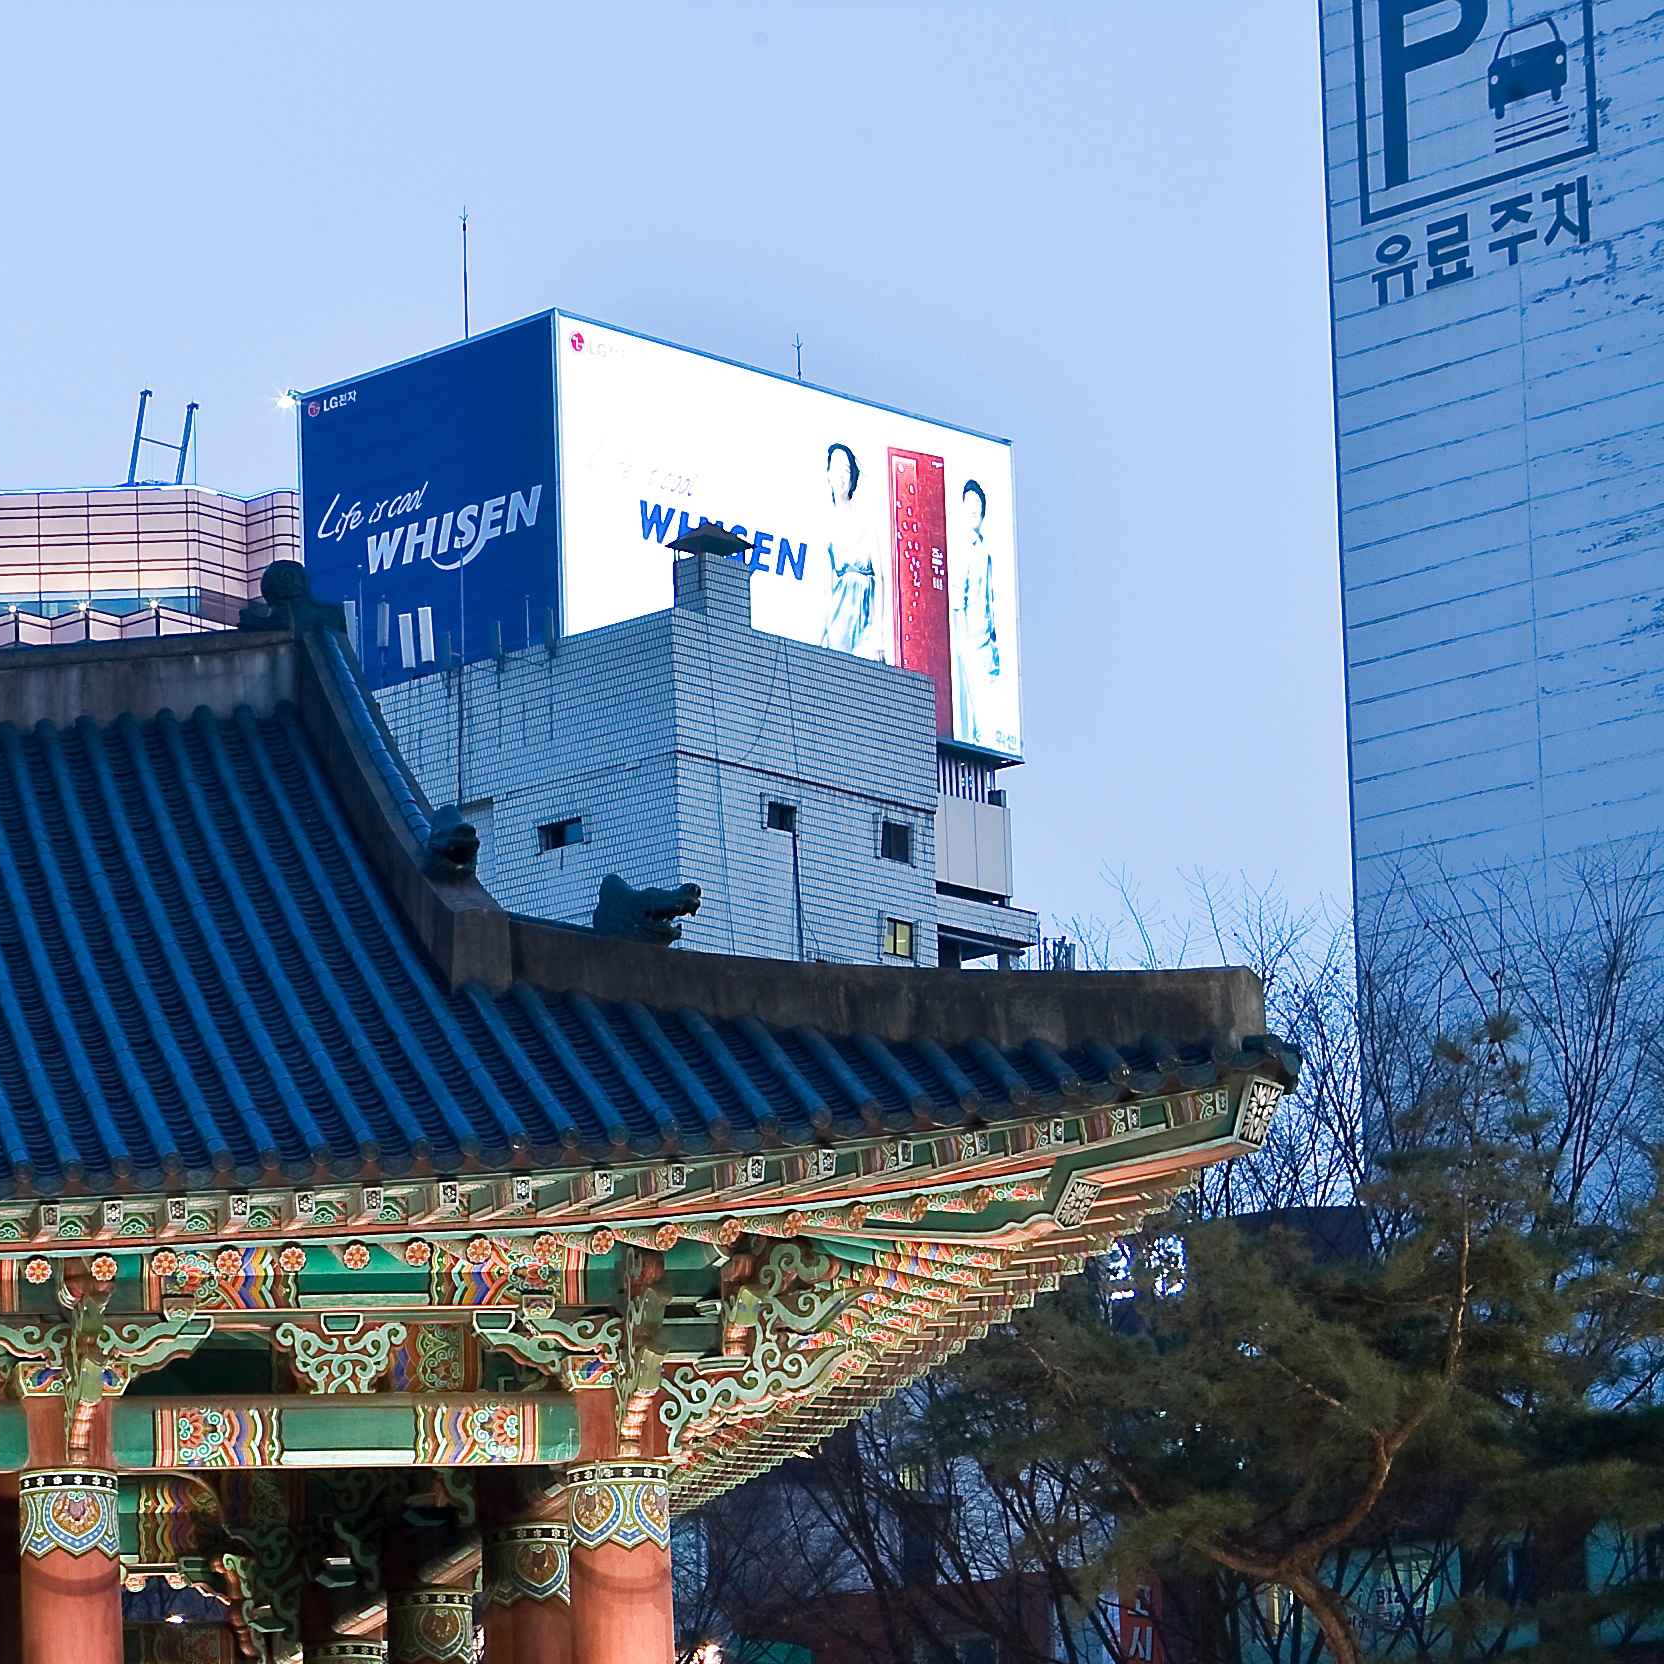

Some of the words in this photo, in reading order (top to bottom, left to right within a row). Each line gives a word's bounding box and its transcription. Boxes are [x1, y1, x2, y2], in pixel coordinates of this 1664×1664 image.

[323, 389, 358, 412] LG전자
[317, 493, 364, 542] Life
[368, 501, 383, 525] is
[387, 480, 429, 516] cool
[367, 484, 543, 575] WHISEN
